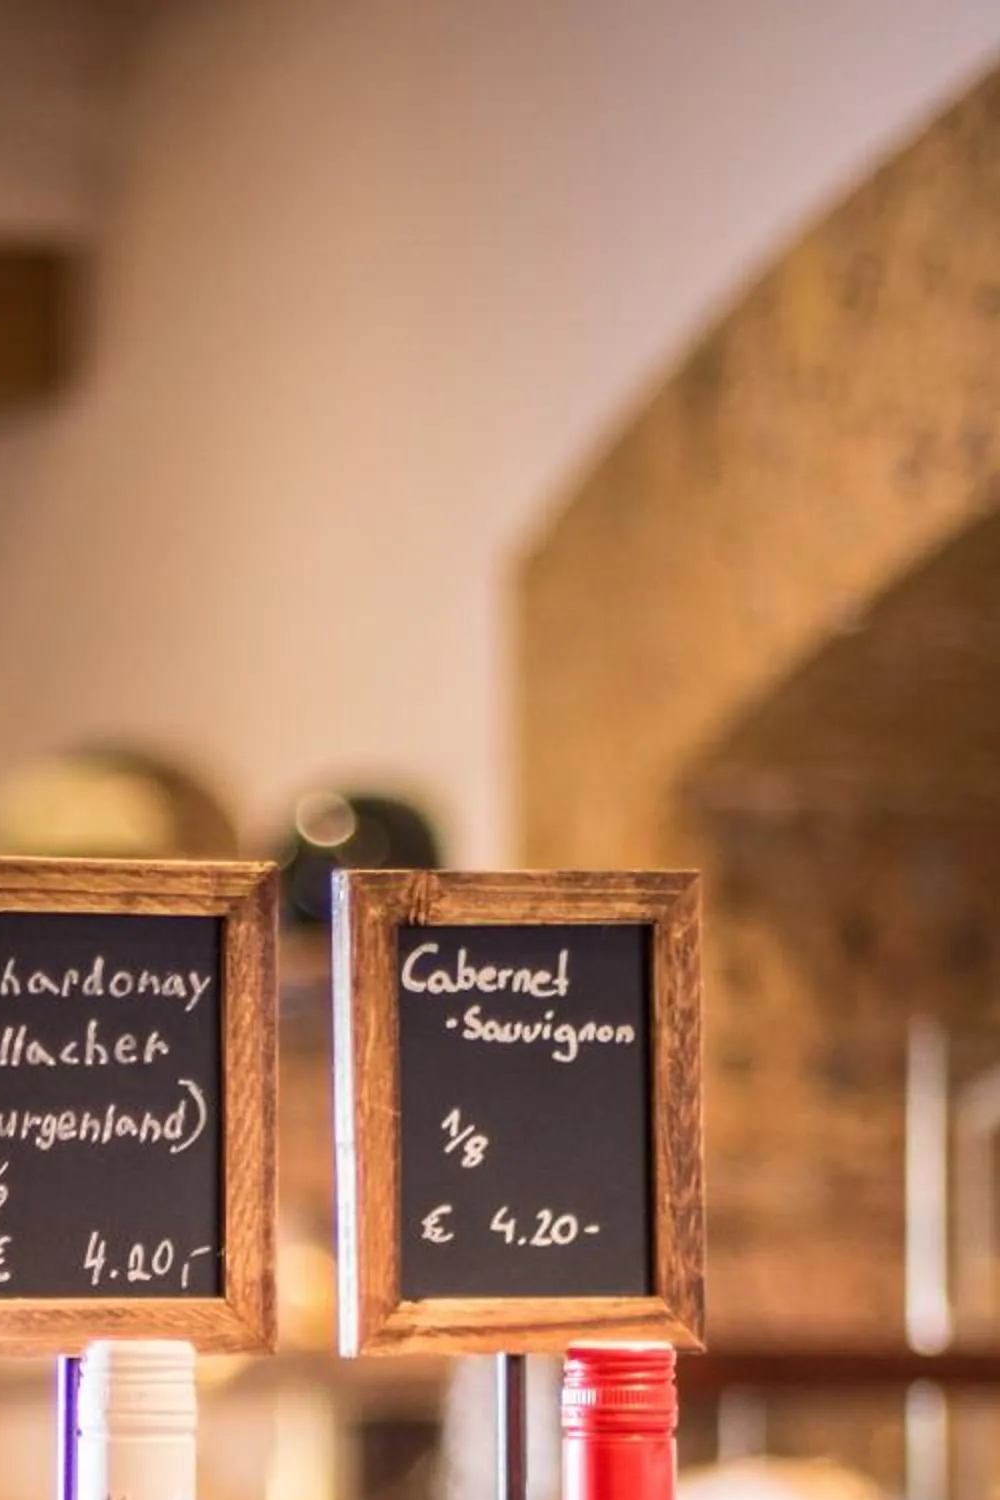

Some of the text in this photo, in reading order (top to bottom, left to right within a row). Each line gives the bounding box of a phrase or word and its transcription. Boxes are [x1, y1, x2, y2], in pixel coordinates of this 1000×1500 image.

[401, 943, 569, 998] Cabernet
[441, 1108, 489, 1169] 1/8
[421, 1204, 600, 1247] € 4.20-
